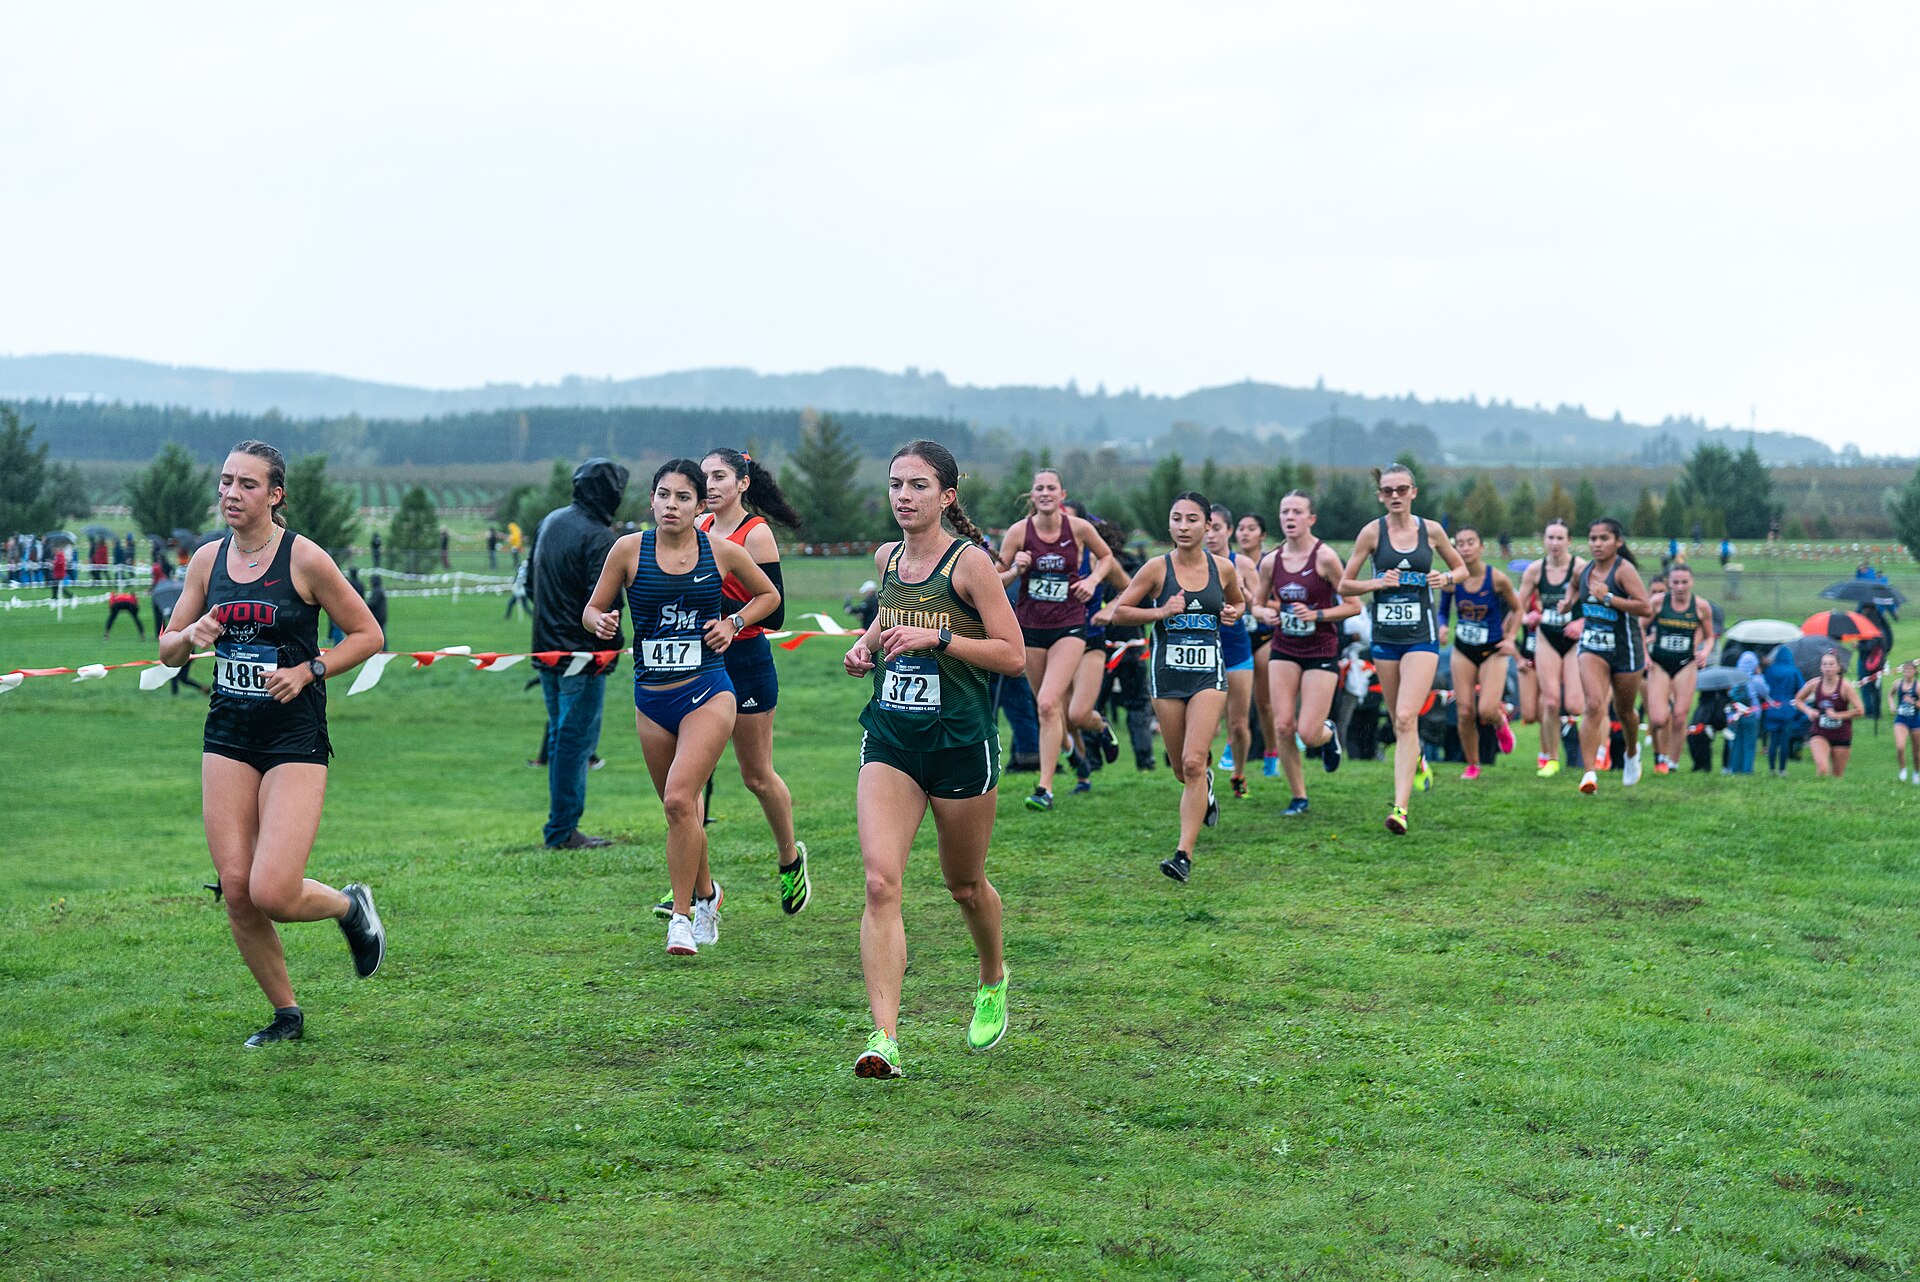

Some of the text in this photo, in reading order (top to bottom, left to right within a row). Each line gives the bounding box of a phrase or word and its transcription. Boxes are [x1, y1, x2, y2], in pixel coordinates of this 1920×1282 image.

[1035, 581, 1061, 597] 247
[217, 603, 274, 625] WOU
[660, 604, 699, 631] SM
[879, 606, 906, 627] OINT
[1385, 604, 1413, 620] 296
[652, 642, 690, 665] 417
[1175, 647, 1206, 665] 300
[225, 662, 266, 689] 486
[889, 674, 929, 703] 372
